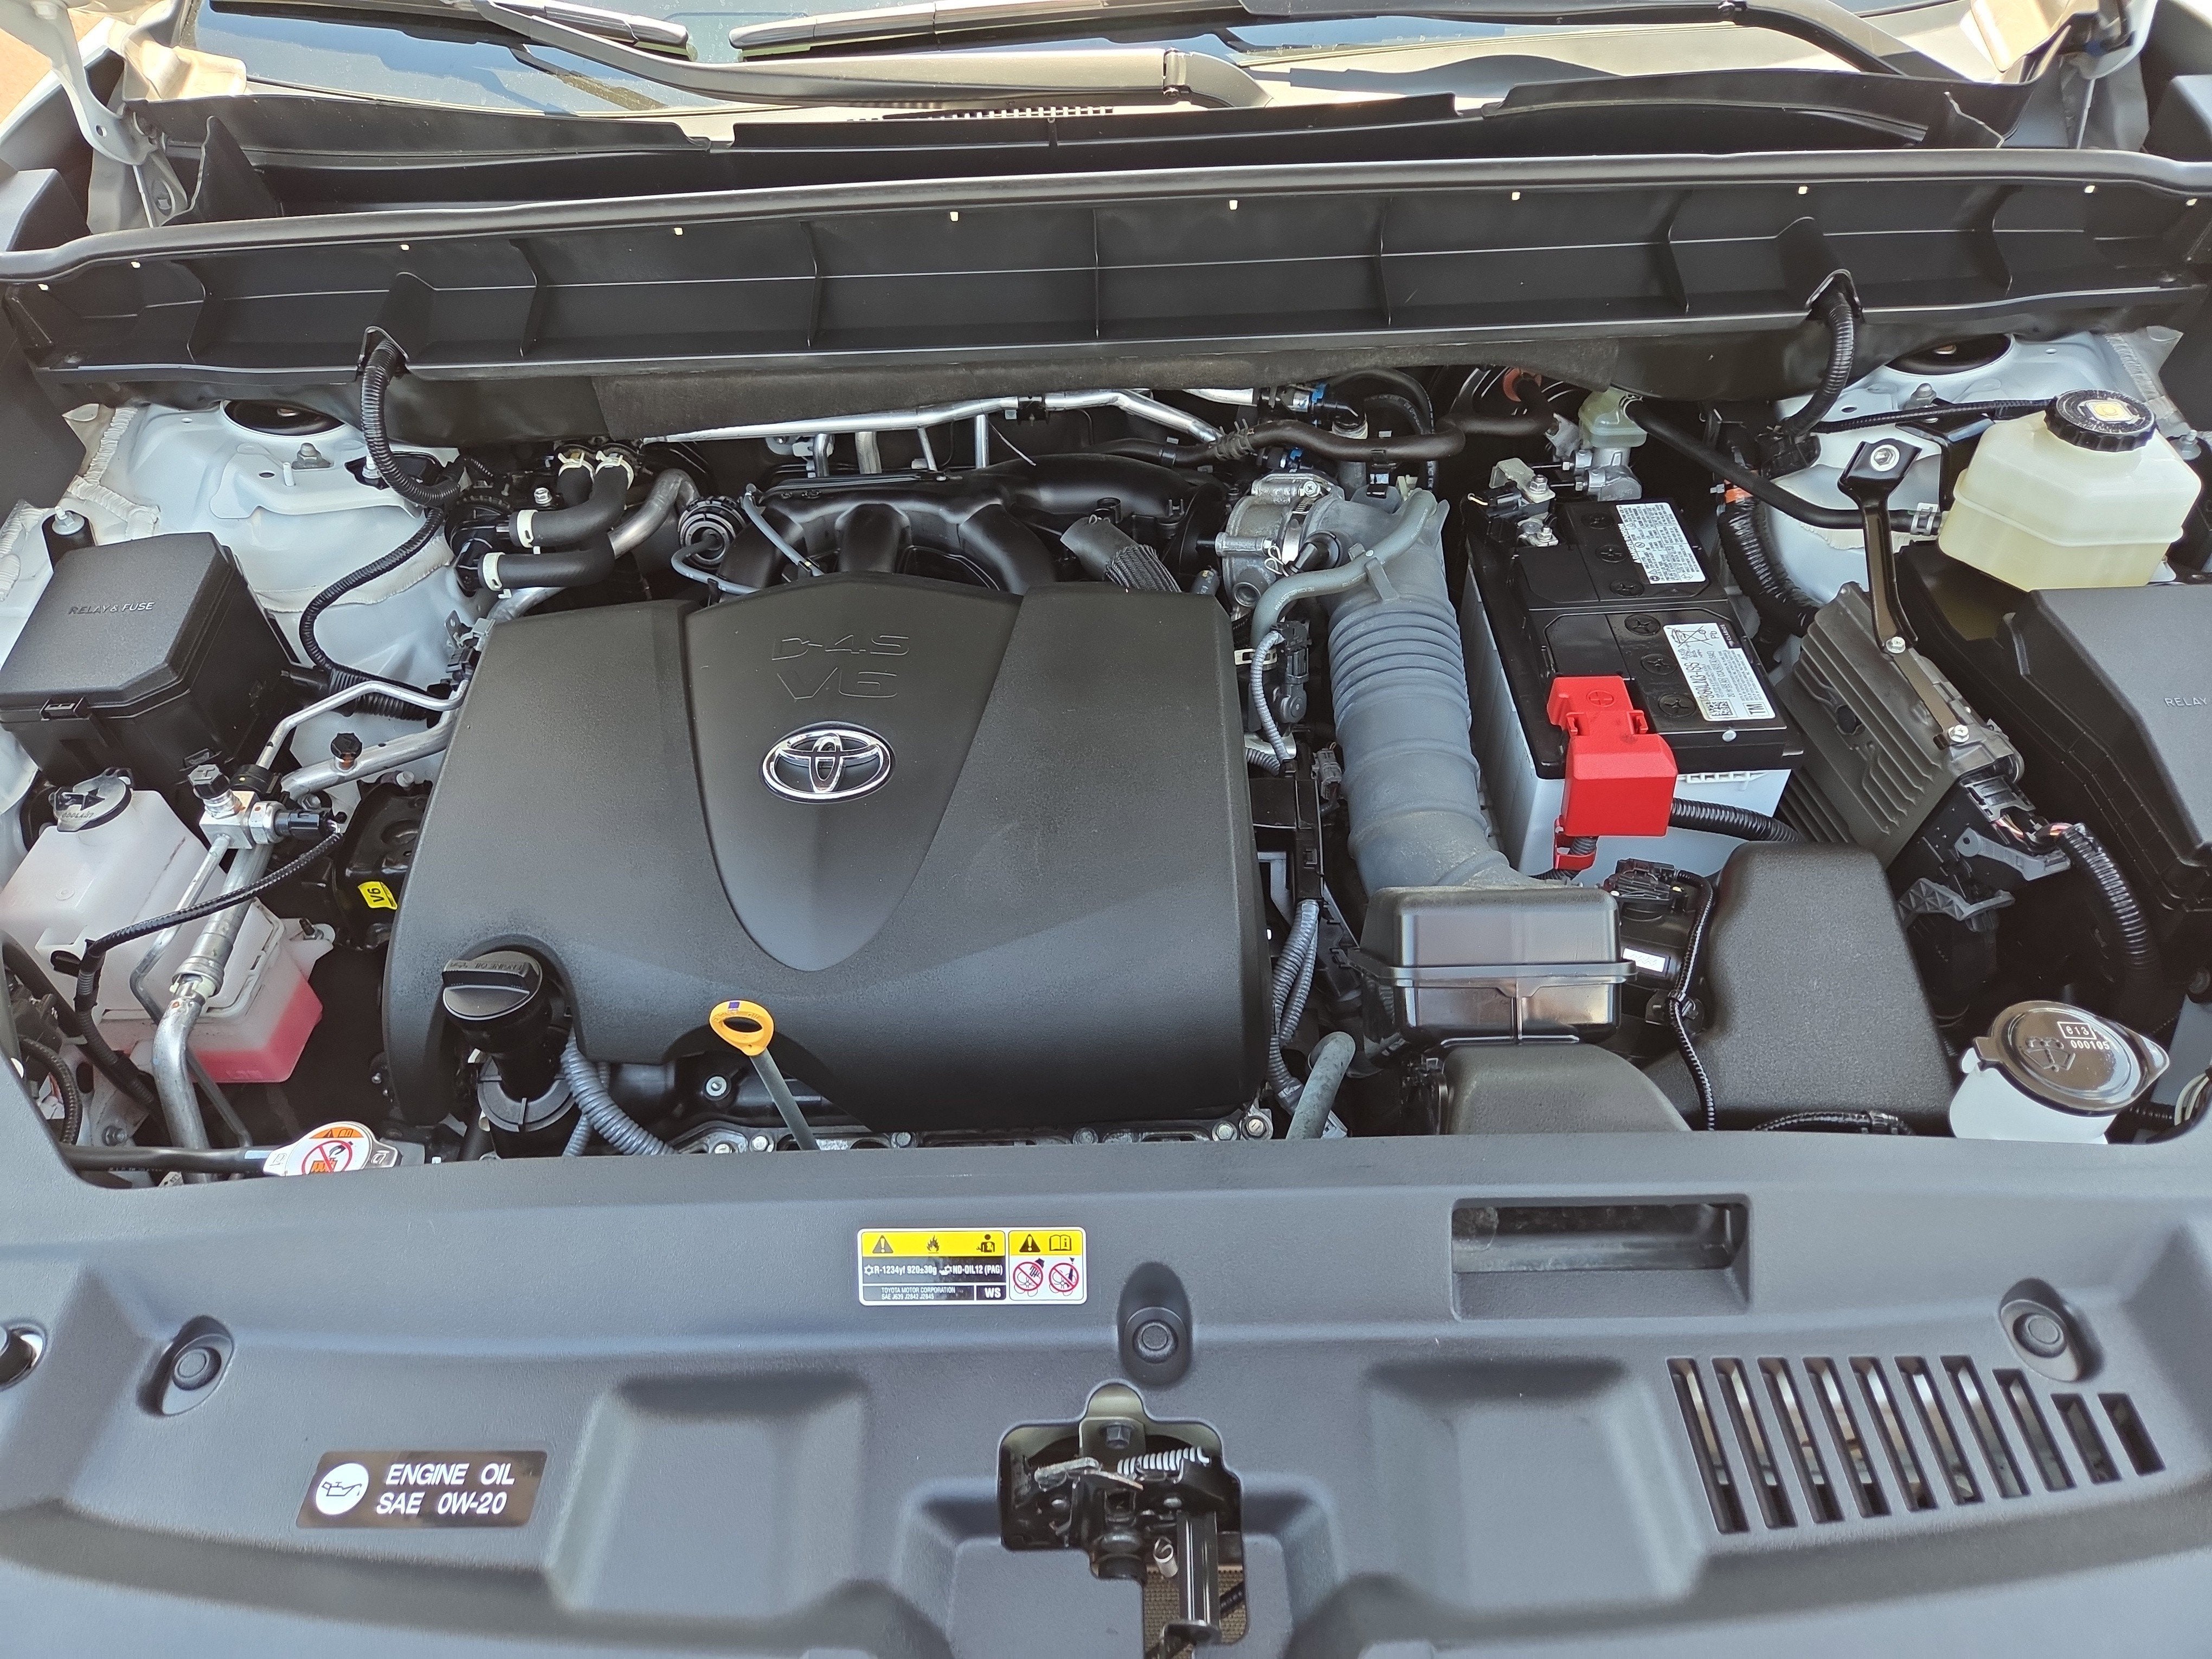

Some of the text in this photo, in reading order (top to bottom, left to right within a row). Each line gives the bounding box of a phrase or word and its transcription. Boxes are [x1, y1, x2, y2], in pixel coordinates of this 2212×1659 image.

[122, 596, 156, 612] FUSE
[776, 665, 898, 699] V6
[1684, 662, 1714, 699] 380LN3-ISS
[2164, 697, 2207, 706] RELAY
[1746, 704, 1766, 715] TM
[367, 888, 385, 903] V6
[2070, 1040, 2110, 1050] 000105
[874, 1264, 1003, 1276] R-1234yf 920±30g ND-OIL12 (PAG)
[984, 1287, 1001, 1298] WS
[385, 1463, 515, 1485] ENGINE OIL
[377, 1491, 507, 1514] SAE 0W-20
